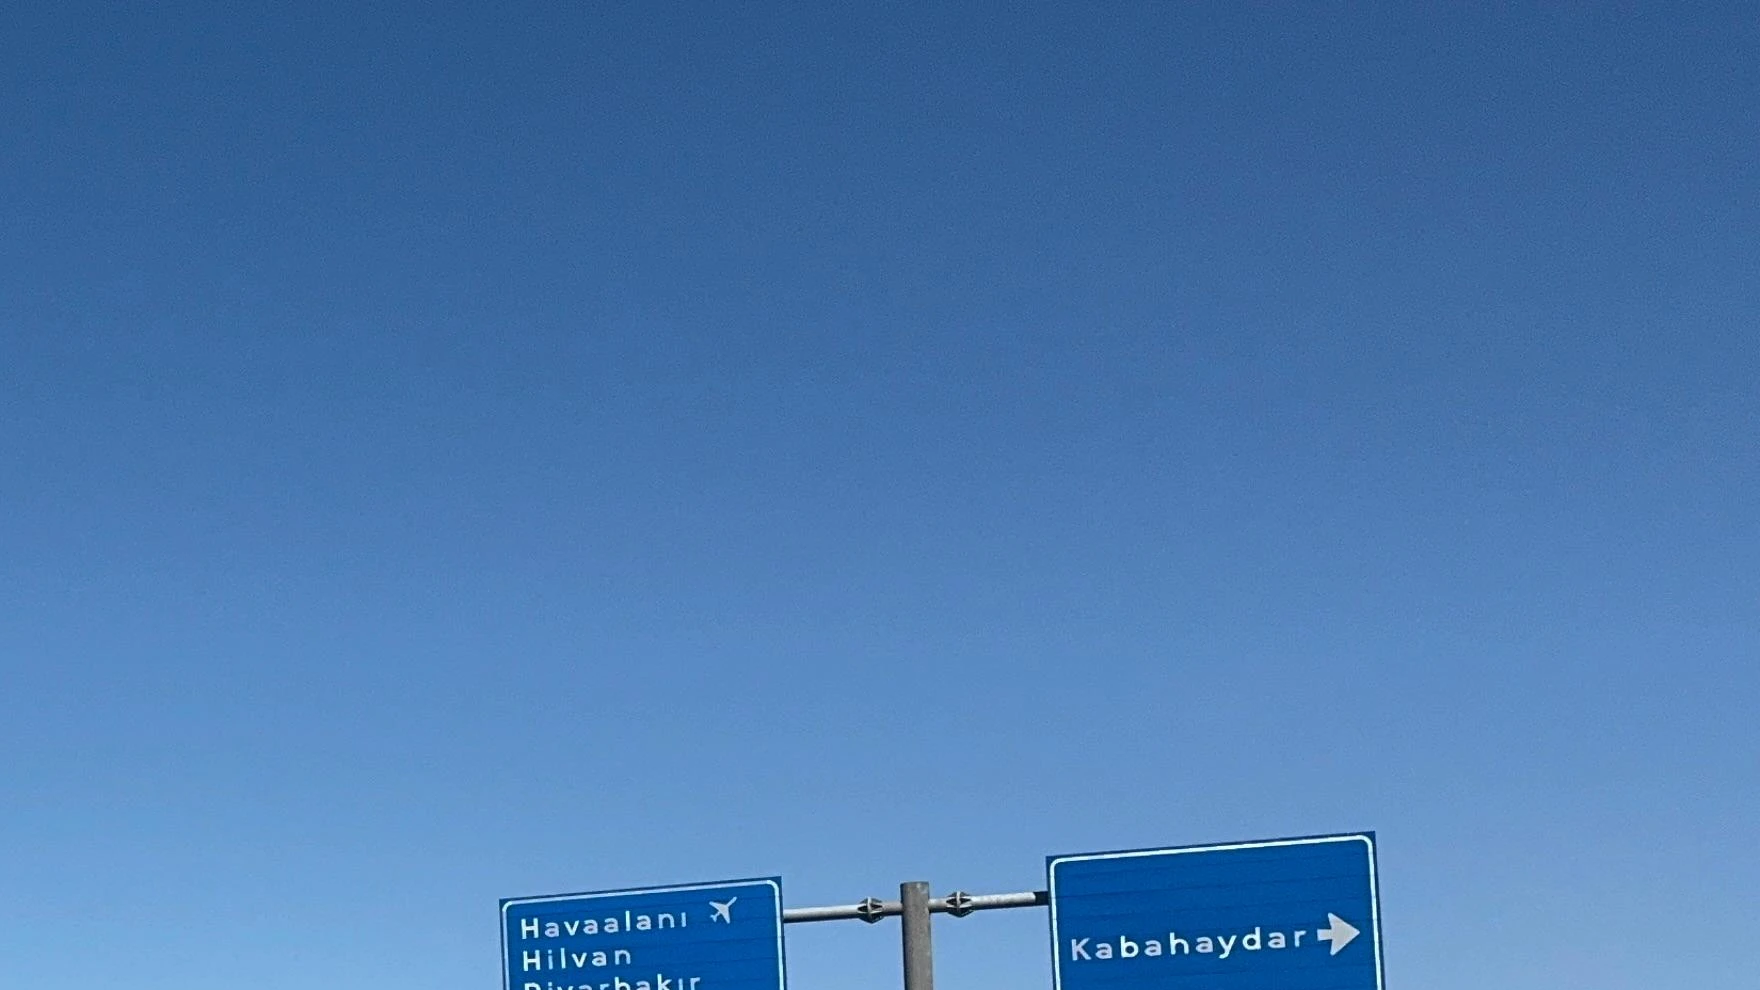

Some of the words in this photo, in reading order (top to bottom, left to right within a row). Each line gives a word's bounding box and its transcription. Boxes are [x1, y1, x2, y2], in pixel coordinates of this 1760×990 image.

[521, 909, 688, 940] Havaalanı
[522, 946, 631, 972] Hilvan
[1071, 926, 1307, 962] Kabahaydar
